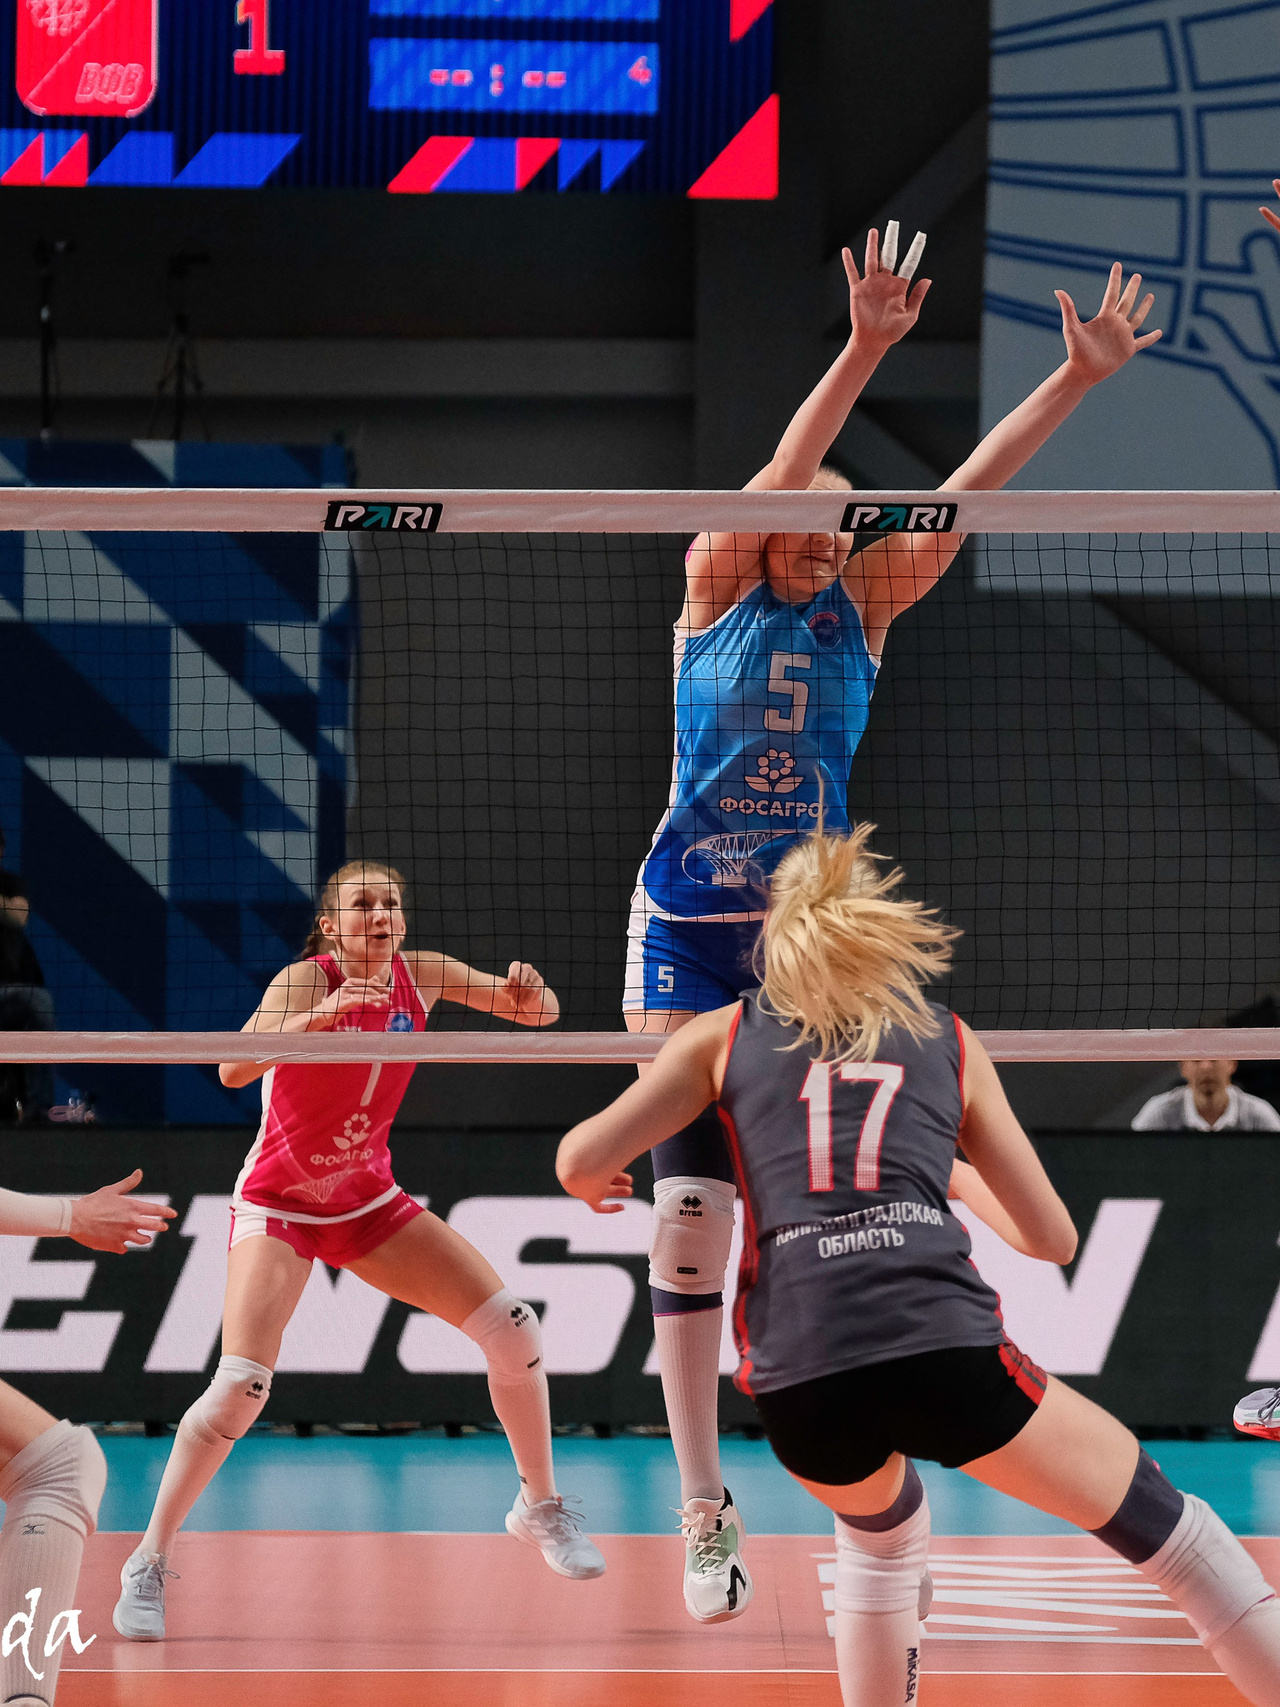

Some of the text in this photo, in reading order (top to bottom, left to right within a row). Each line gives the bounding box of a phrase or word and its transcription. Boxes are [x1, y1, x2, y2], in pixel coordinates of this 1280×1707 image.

[234, 0, 285, 75] 1
[333, 505, 435, 529] PARI
[849, 505, 951, 529] PARI
[763, 650, 813, 735] 5
[719, 797, 821, 819] ФОСАГРО
[657, 966, 674, 993] 5
[798, 1061, 905, 1192] 17
[818, 1228, 905, 1259] ОБЛАСТЬ
